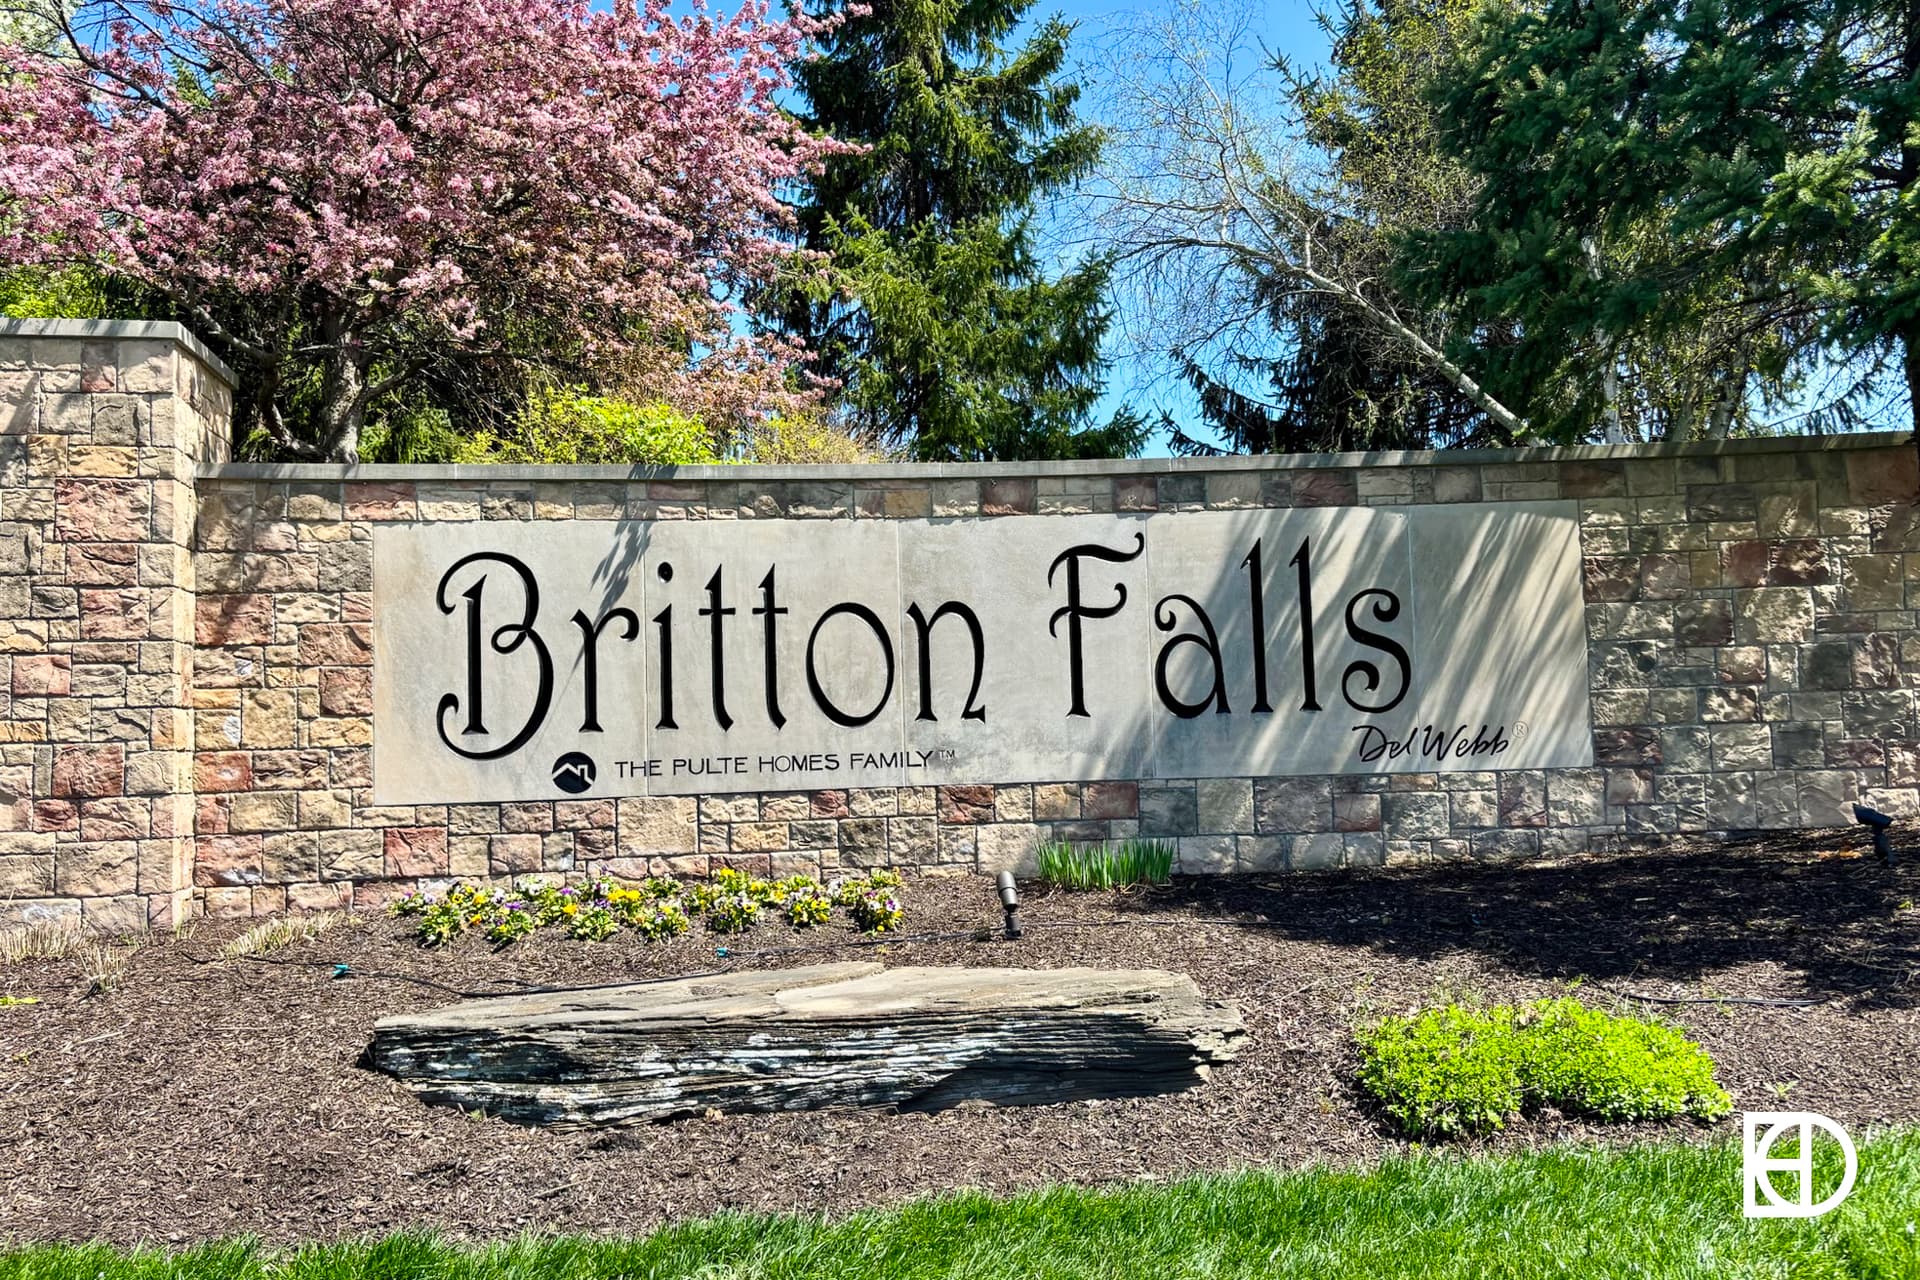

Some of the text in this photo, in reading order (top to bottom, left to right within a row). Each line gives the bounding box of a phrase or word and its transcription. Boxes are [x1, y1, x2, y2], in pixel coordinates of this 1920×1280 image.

[437, 531, 1412, 760] Britton Falls
[1352, 725, 1418, 762] Del
[614, 760, 663, 778] THE
[672, 756, 749, 776] PULTE
[758, 753, 840, 774] HOMES
